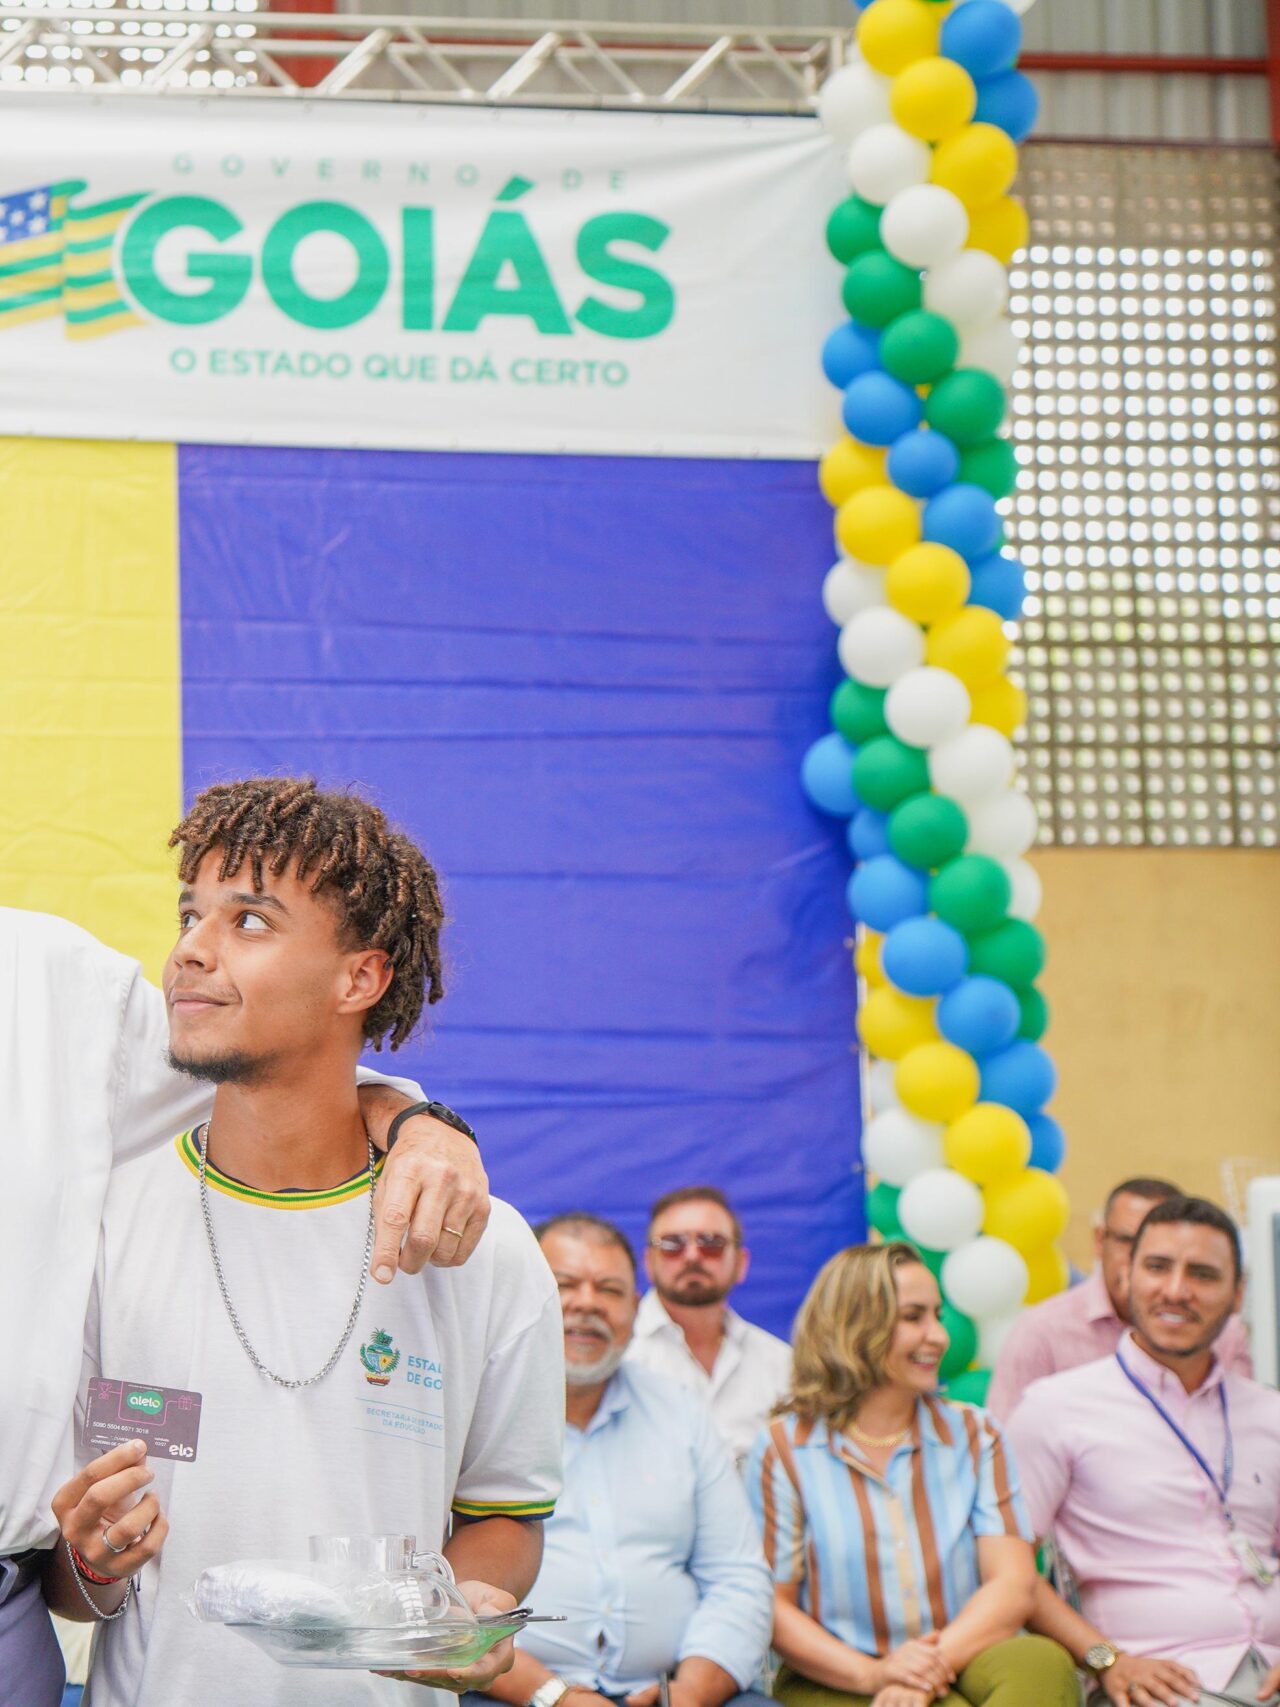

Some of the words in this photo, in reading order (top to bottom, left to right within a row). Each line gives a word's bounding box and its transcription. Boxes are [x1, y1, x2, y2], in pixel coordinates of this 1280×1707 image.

[173, 154, 479, 186] GOVERNO
[563, 168, 626, 191] DE
[122, 175, 676, 339] GOIÁS
[170, 347, 196, 375] O
[210, 349, 352, 379] ESTADO
[363, 354, 439, 382] QUE
[450, 351, 499, 382] DÁ
[510, 358, 629, 388] CERTO
[407, 1371, 420, 1385] DE
[130, 1396, 160, 1408] alelo
[367, 1407, 411, 1420] SECRETARIA
[169, 1443, 194, 1458] elo
